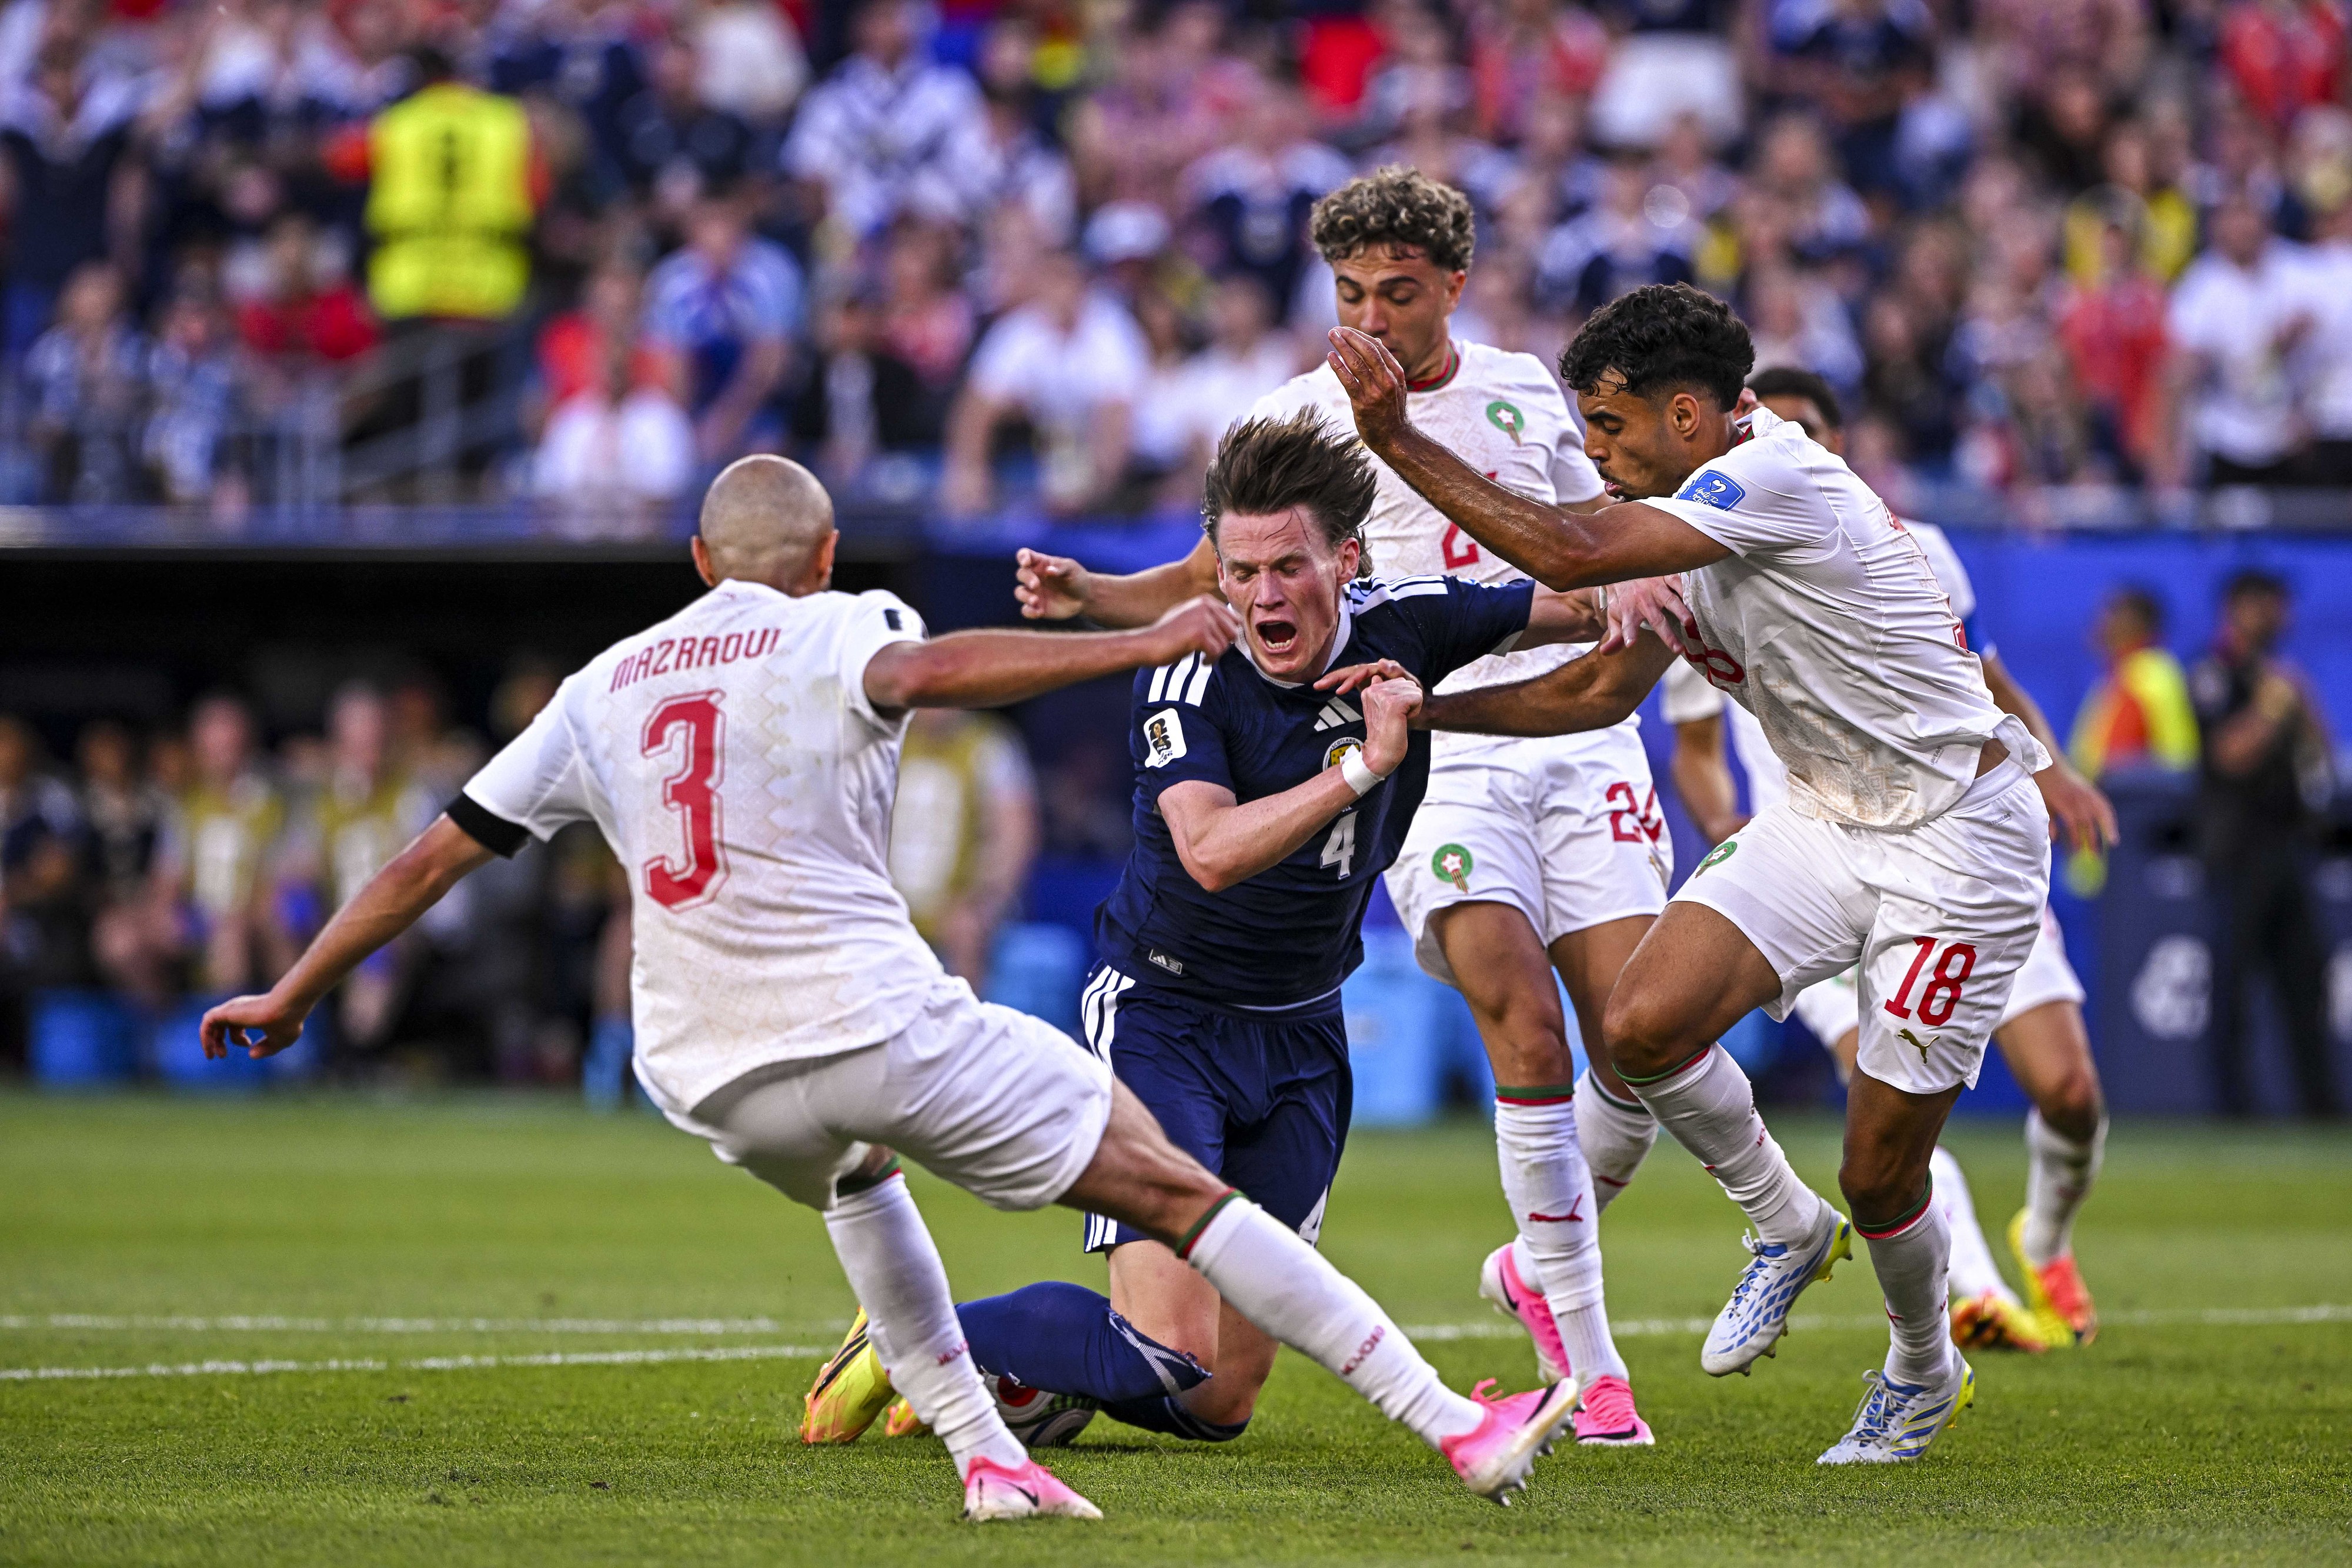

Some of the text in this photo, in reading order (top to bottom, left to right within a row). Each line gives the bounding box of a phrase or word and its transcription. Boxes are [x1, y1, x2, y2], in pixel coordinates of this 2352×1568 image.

[609, 628, 781, 693] MAZRAOUI
[641, 688, 730, 914] 3
[1319, 810, 1358, 880] 4
[1884, 935, 1977, 1027] 18
